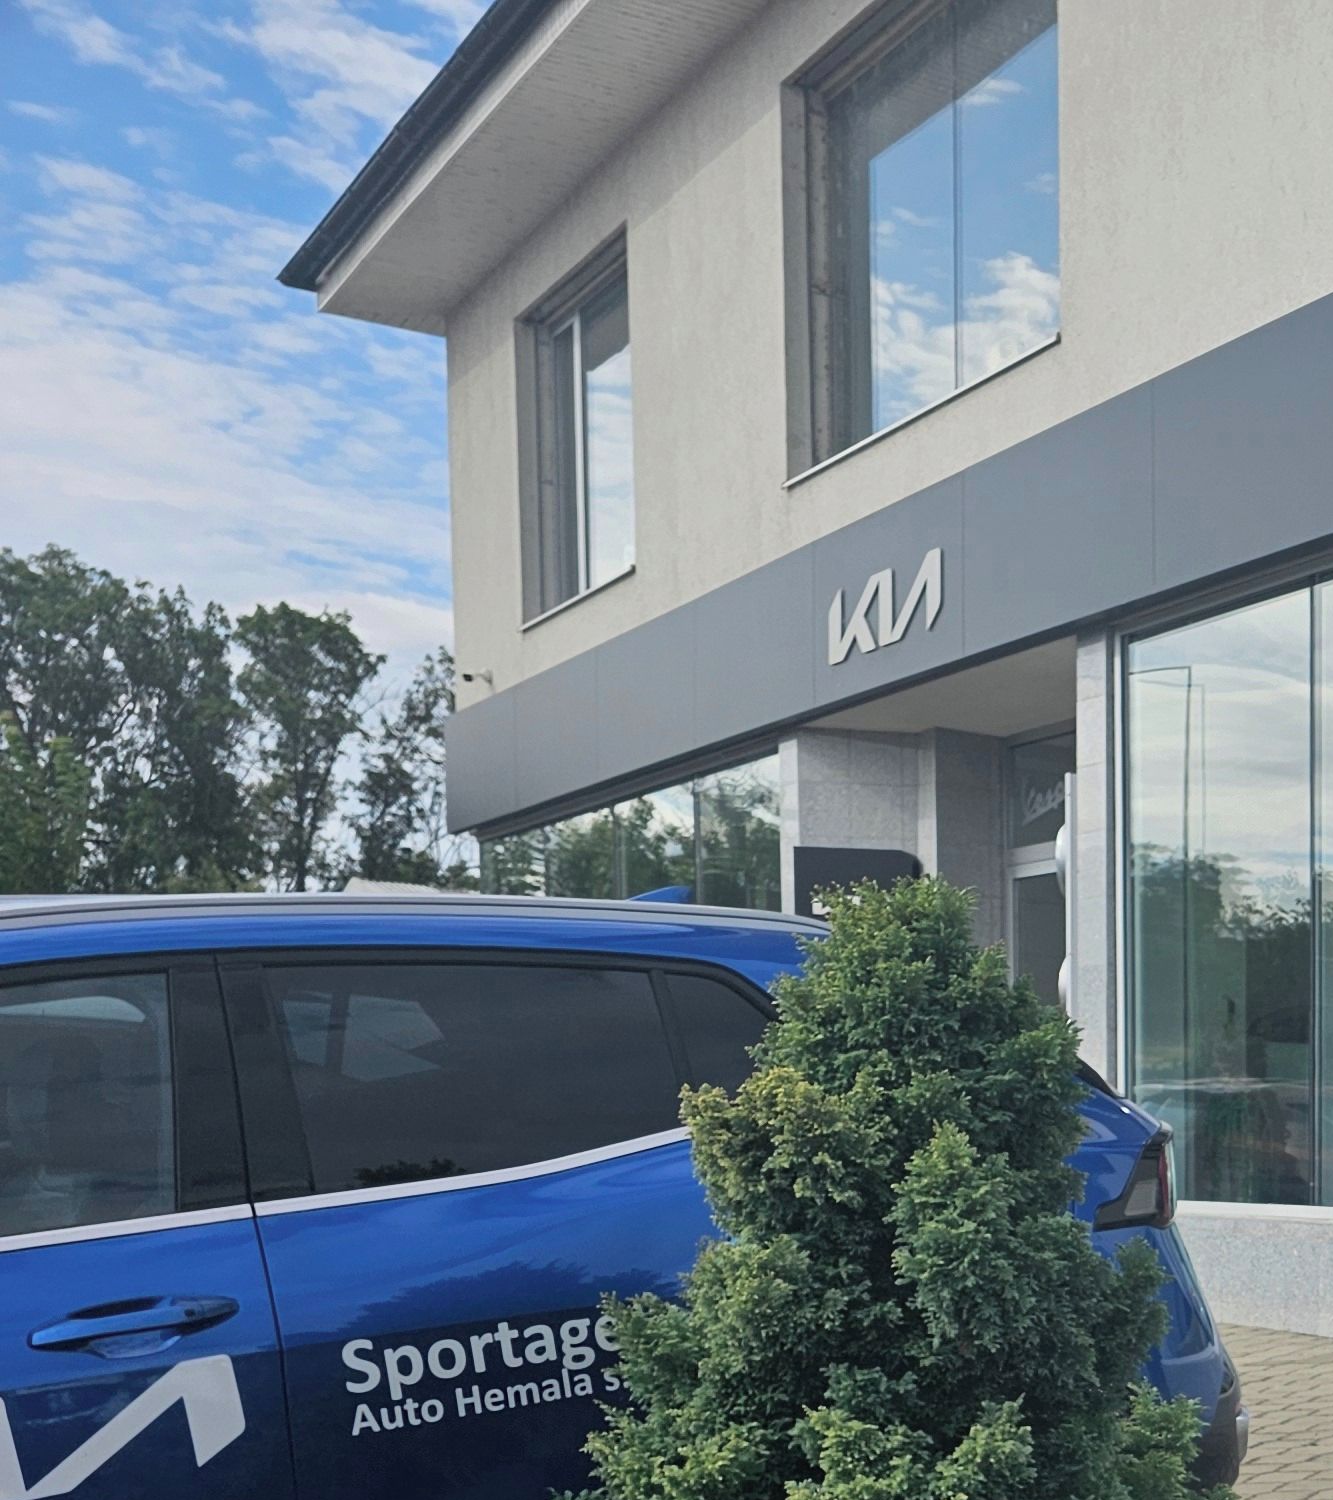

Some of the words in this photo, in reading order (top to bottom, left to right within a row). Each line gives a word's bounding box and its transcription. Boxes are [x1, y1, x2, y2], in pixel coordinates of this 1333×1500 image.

[828, 547, 943, 667] KIA
[342, 1315, 620, 1401] Sportage
[352, 1397, 444, 1436] Auto
[455, 1368, 593, 1417] Hemala
